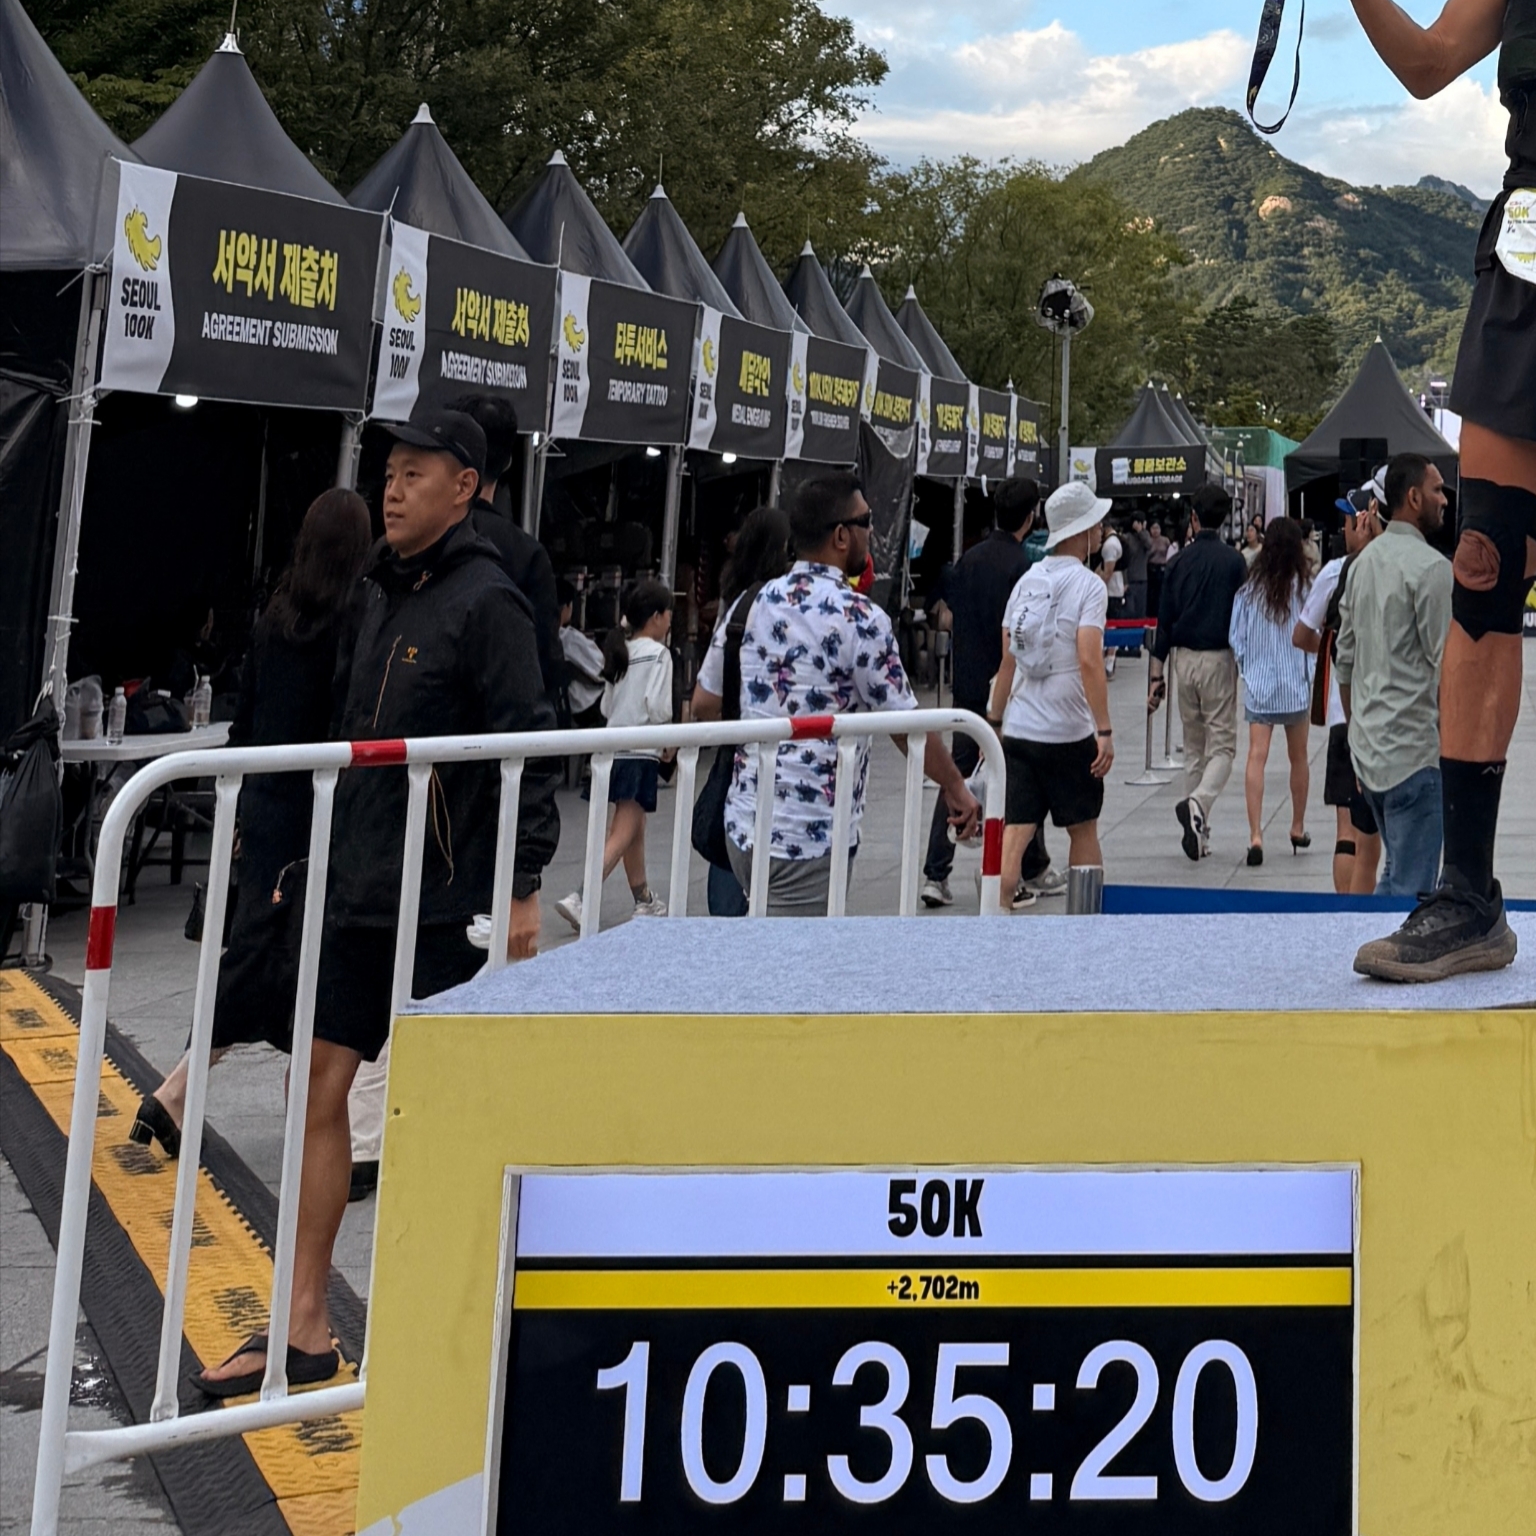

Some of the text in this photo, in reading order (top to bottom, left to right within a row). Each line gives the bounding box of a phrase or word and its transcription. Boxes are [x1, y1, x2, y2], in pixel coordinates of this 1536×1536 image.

[1507, 205, 1529, 219] 50K
[212, 229, 339, 311] 서약서 제출처
[121, 277, 161, 311] SEOUL
[124, 313, 155, 340] 100K
[202, 312, 339, 355] AGREEMENT SUBMISSION
[452, 287, 530, 347] 서약서 제출처
[389, 327, 415, 351] SEOUL
[614, 322, 668, 370] 타투서비스
[390, 354, 410, 379] 100K
[441, 350, 487, 384] AGREEMENT
[607, 378, 668, 407] TEMPORARY TATTOO
[886, 1178, 983, 1238] 50K
[886, 1274, 980, 1305] +2,702m
[596, 1339, 1259, 1506] 10:35:20
